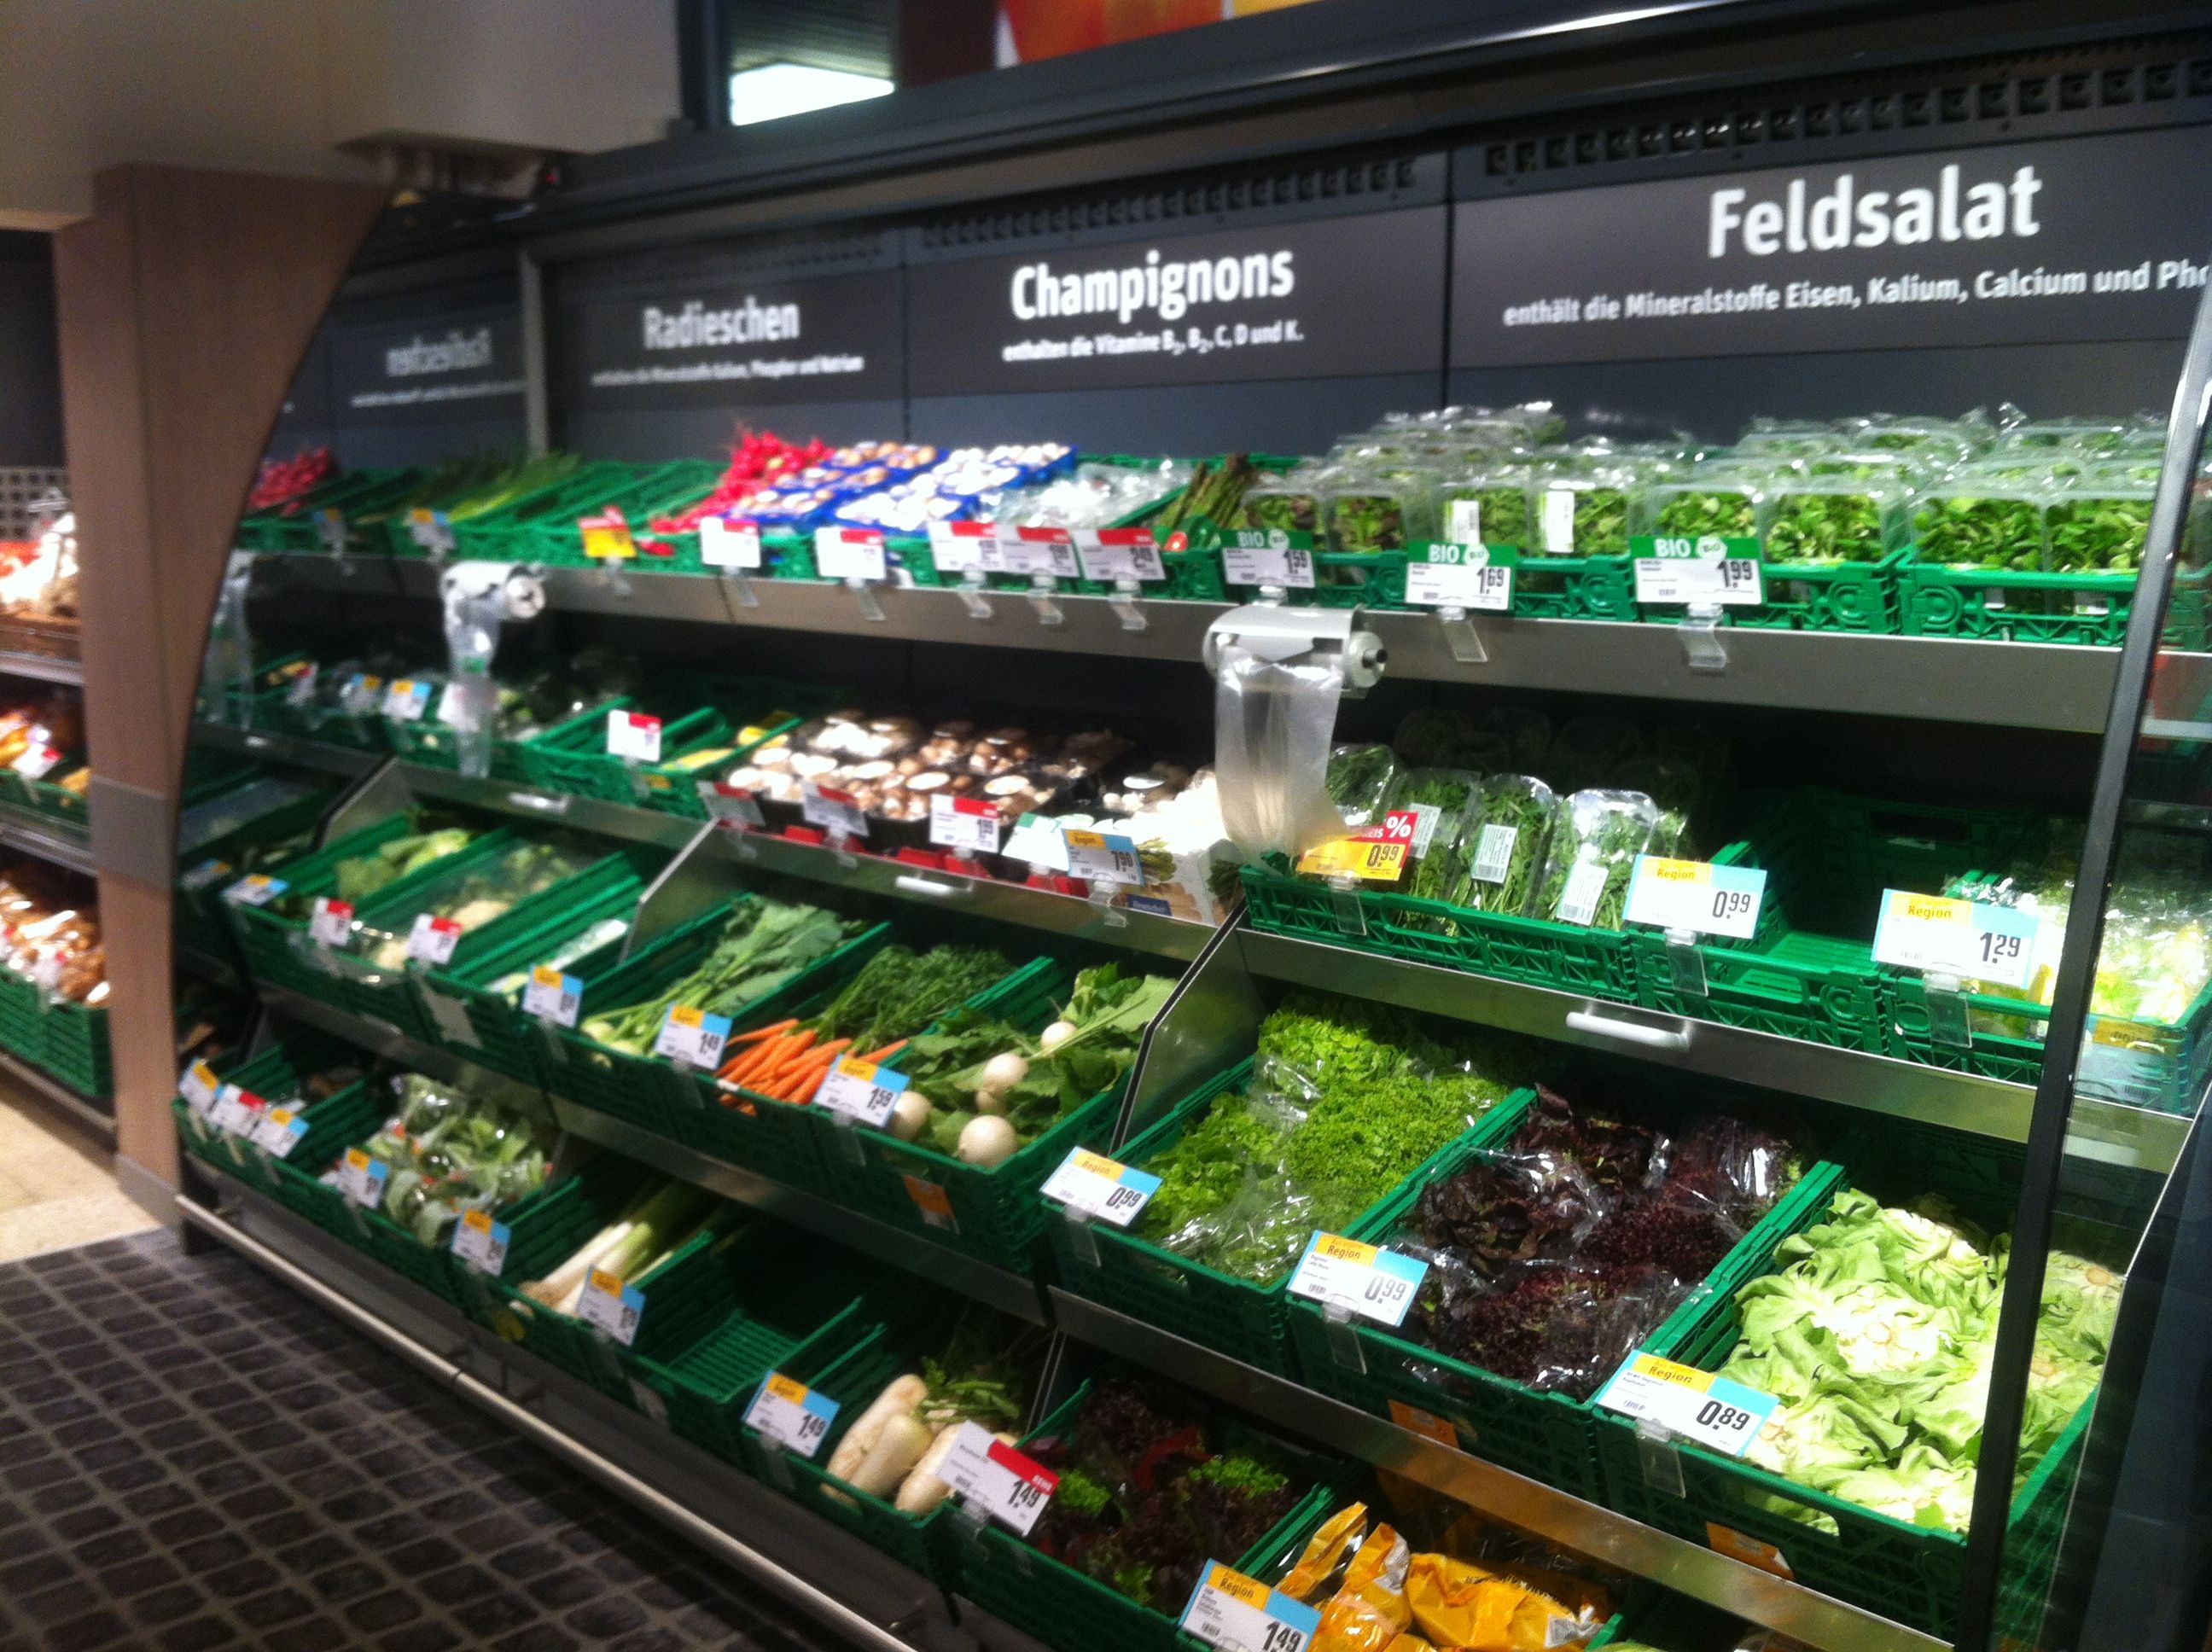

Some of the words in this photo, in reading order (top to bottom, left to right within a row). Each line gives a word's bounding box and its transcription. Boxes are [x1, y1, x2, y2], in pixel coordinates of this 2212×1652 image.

[1709, 165, 2043, 258] Feldsalat
[1010, 250, 1295, 323] Champignons
[1503, 297, 1580, 326] enthält
[1584, 293, 1620, 321] die
[1624, 282, 1779, 318] Mineralstoffe
[1784, 280, 1861, 310] Eisen,
[1866, 273, 1969, 304] Kalium,
[1974, 266, 2087, 300] Calcium
[2092, 261, 2151, 294] und
[644, 295, 800, 349] Radieschen
[1429, 544, 1460, 563] BIO
[1655, 538, 1691, 557] BIO
[1717, 560, 1752, 588] 1.99
[1657, 869, 1695, 881] Region
[1712, 891, 1751, 919] 0.99
[1907, 905, 1952, 920] Region
[1980, 932, 2021, 964] 1.29
[1082, 1160, 1110, 1175] Region
[1106, 1187, 1142, 1209] 0.99
[1327, 1245, 1361, 1259] Region
[1365, 1275, 1406, 1305] 0.99
[1649, 1365, 1692, 1383] Region
[1697, 1400, 1750, 1430] 0.89
[1219, 1577, 1254, 1599] Region
